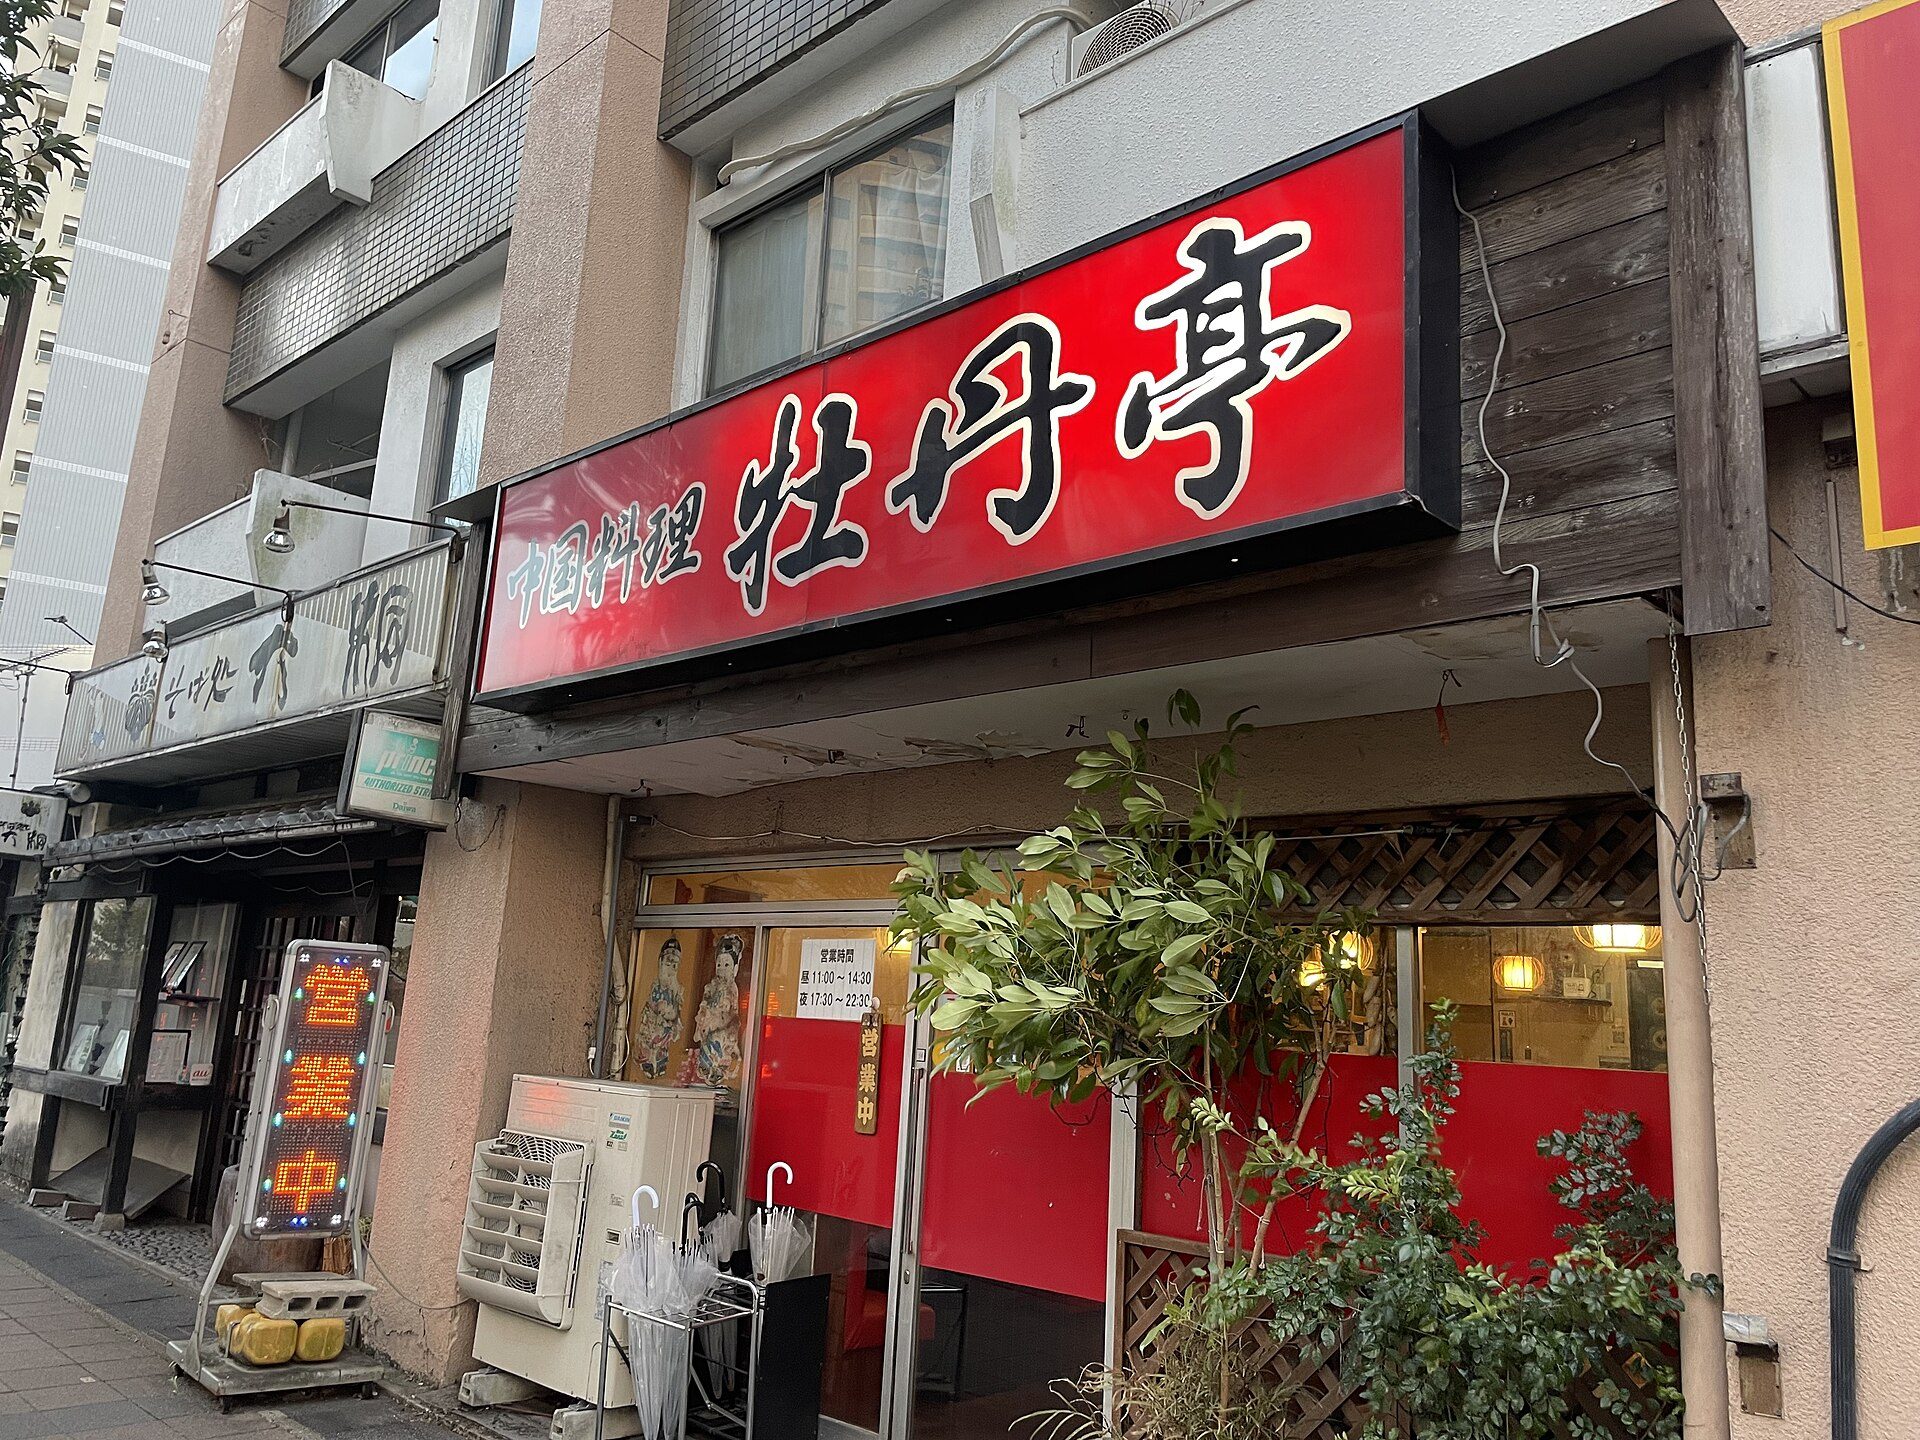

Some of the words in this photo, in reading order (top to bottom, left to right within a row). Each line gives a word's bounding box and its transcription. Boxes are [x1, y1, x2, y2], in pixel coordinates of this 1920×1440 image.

[507, 481, 706, 629] 中国料理
[723, 216, 1352, 617] 牡丹亭
[364, 777, 413, 794] AUTHORIZED
[820, 948, 855, 963] 営業時間
[801, 970, 809, 984] 昼
[812, 970, 835, 984] 11:00
[848, 971, 871, 985] 14:30
[800, 992, 808, 1006] 夜
[811, 992, 833, 1006] 17:30
[192, 1070, 209, 1078] au
[857, 1028, 878, 1125] 営業中
[273, 963, 370, 1214] 営業中
